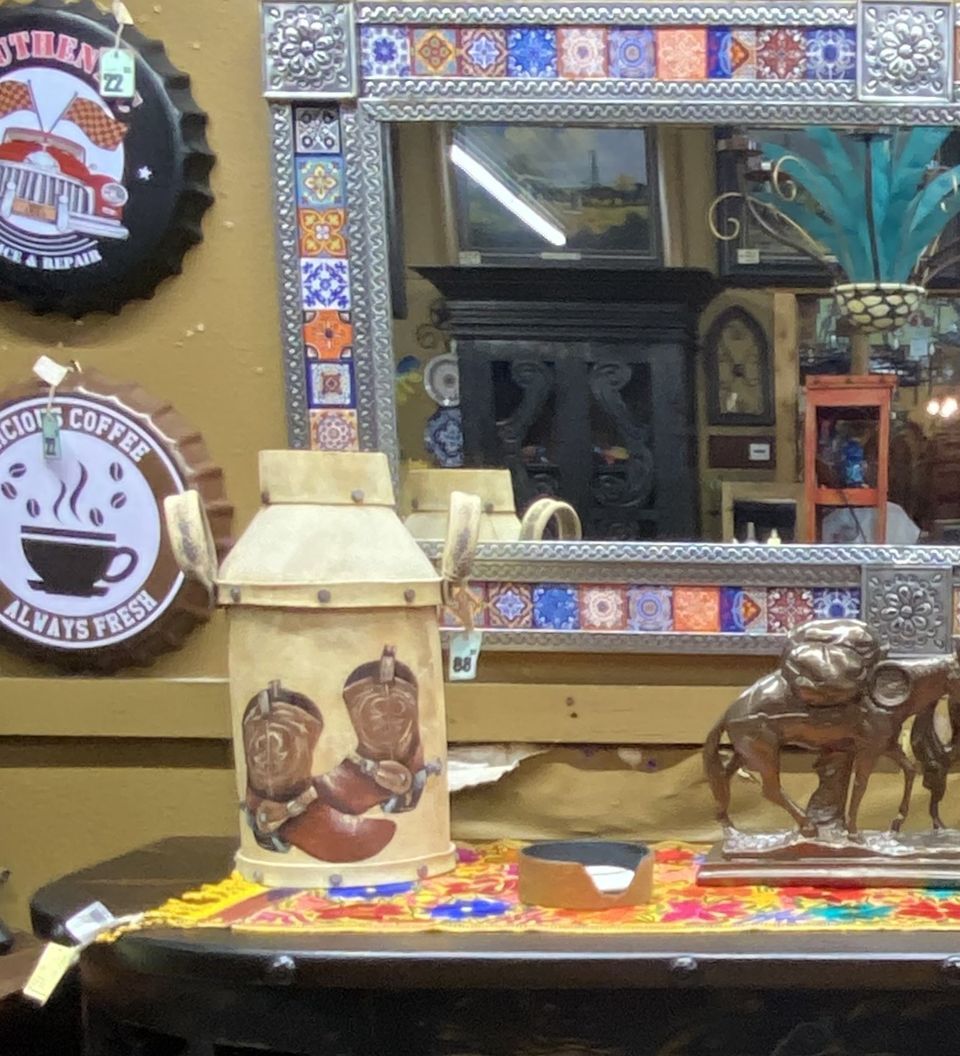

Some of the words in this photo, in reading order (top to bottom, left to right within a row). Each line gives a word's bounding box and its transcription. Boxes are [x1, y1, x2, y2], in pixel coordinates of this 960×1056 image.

[103, 73, 124, 92] 22
[25, 254, 37, 268] &
[42, 249, 102, 270] REPAIR
[69, 408, 151, 462] COFFEE
[3, 600, 89, 640] ALWAYS
[92, 590, 158, 637] FRESH
